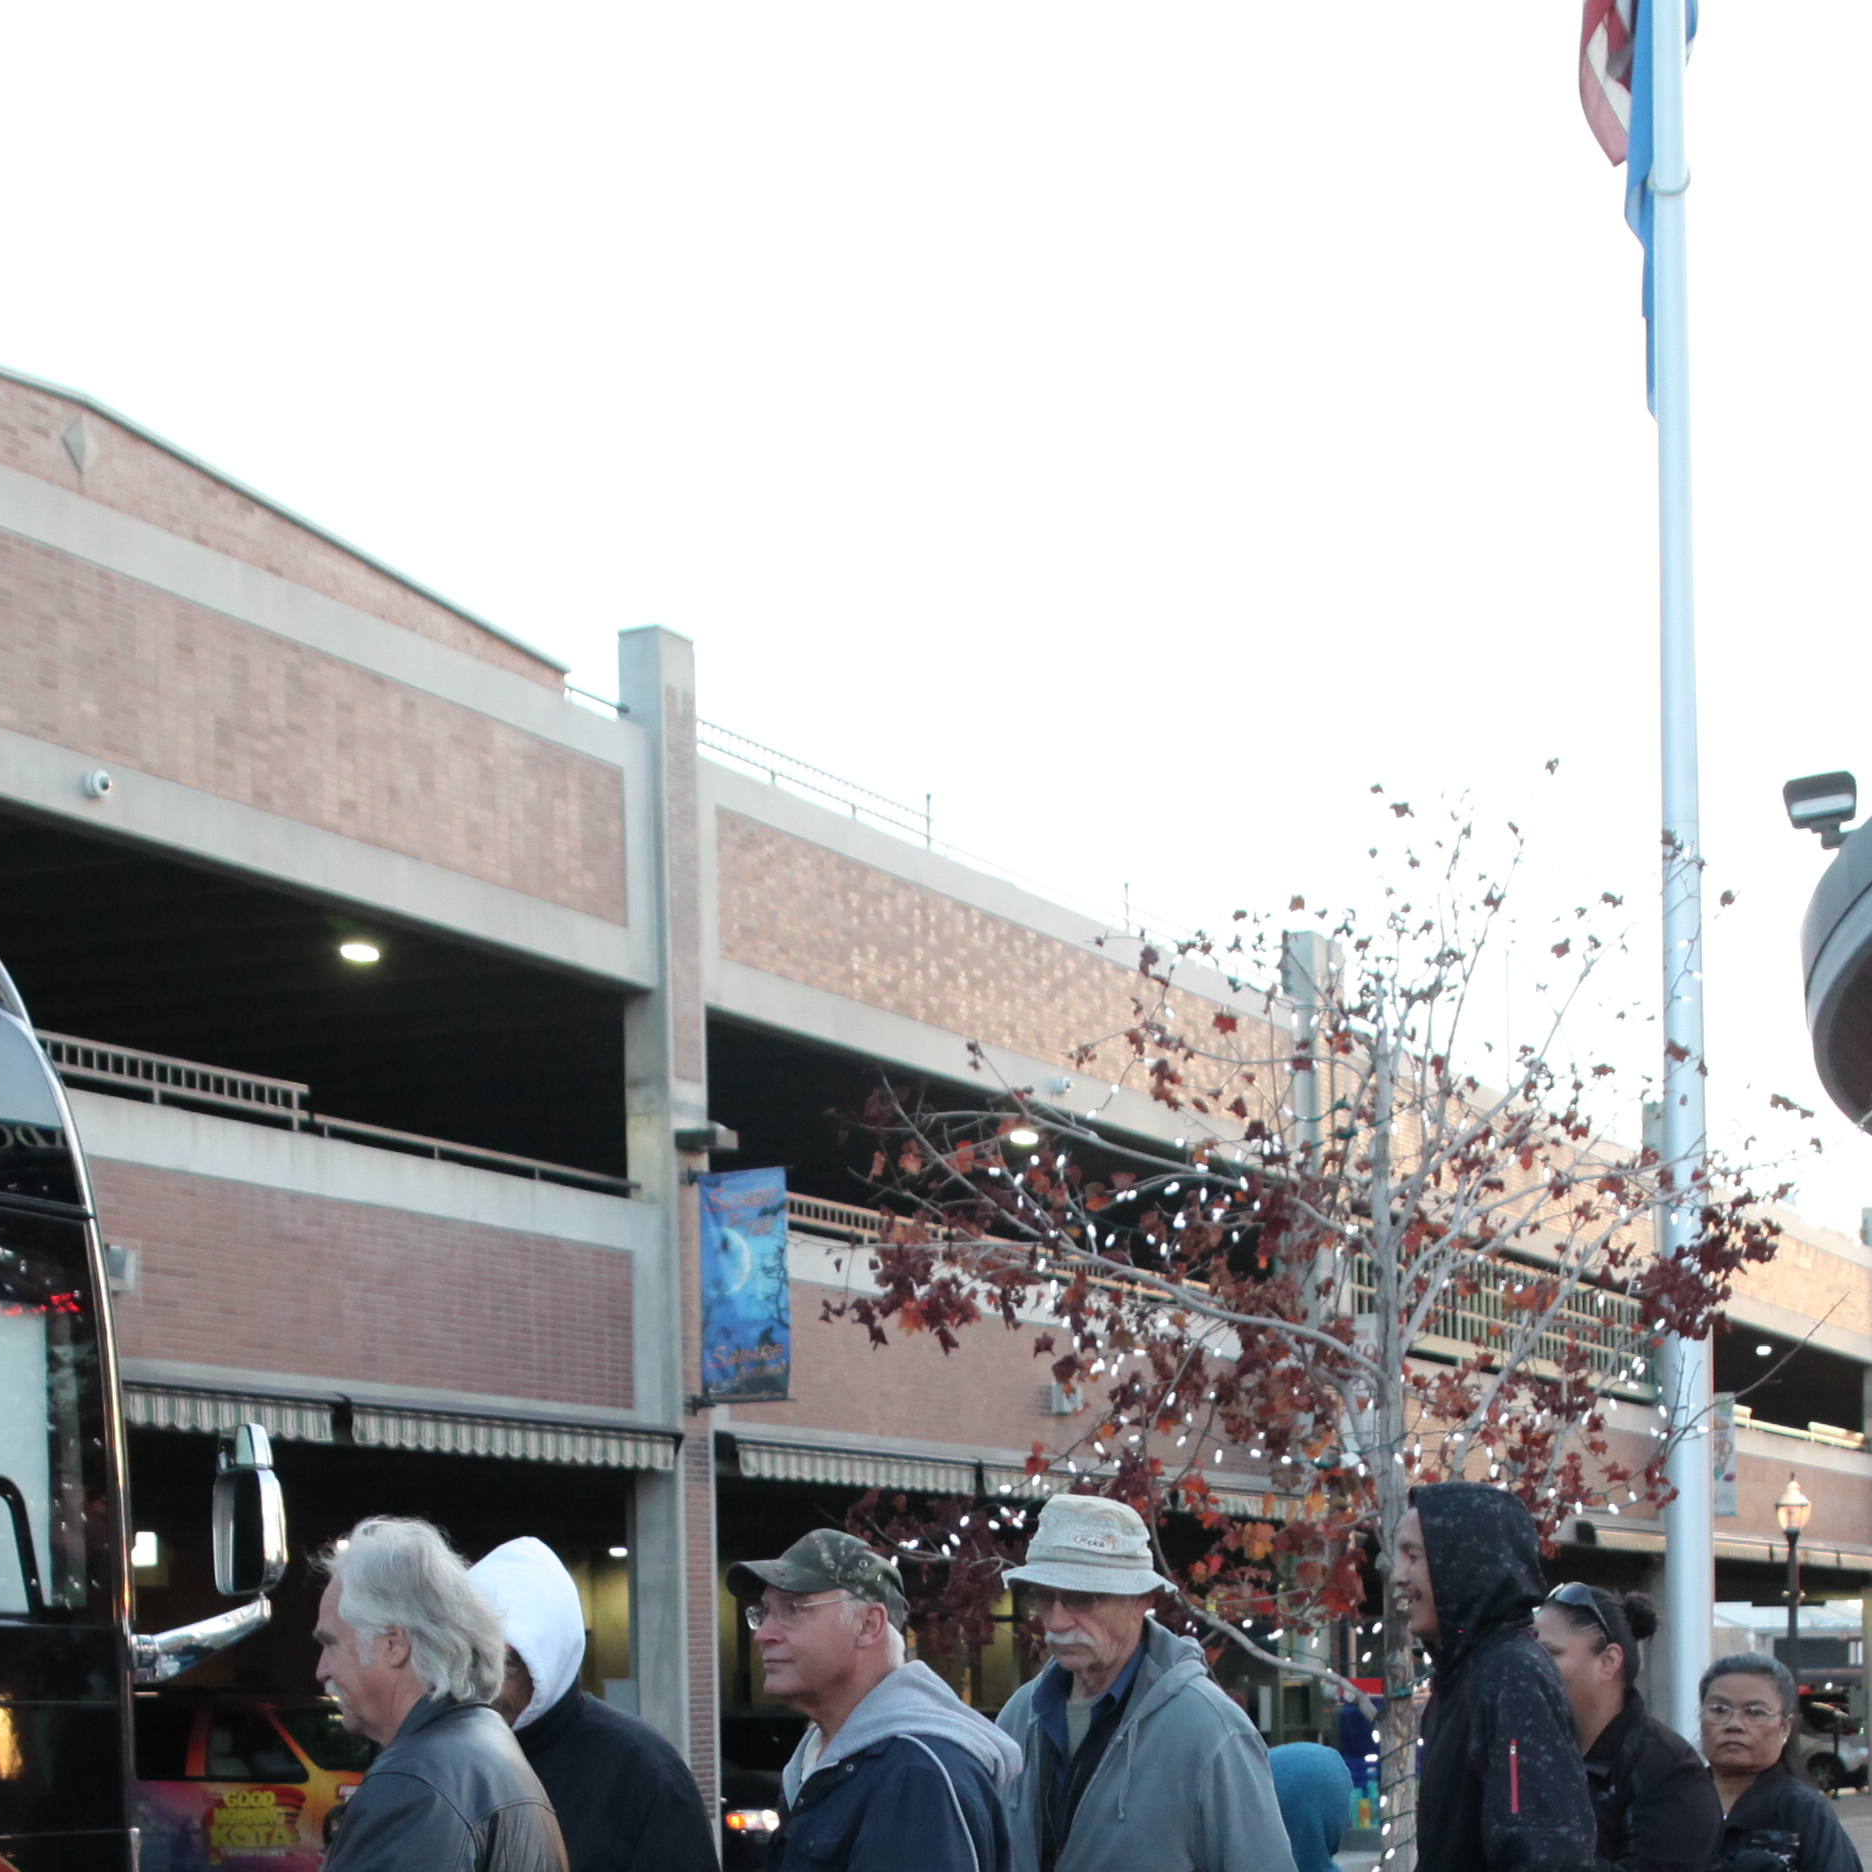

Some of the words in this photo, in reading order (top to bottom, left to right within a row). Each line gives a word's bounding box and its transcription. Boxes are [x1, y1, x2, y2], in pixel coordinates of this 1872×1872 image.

[223, 1790, 276, 1807] GOOD
[213, 1806, 286, 1825] MORNING
[209, 1823, 294, 1848] KOTA
